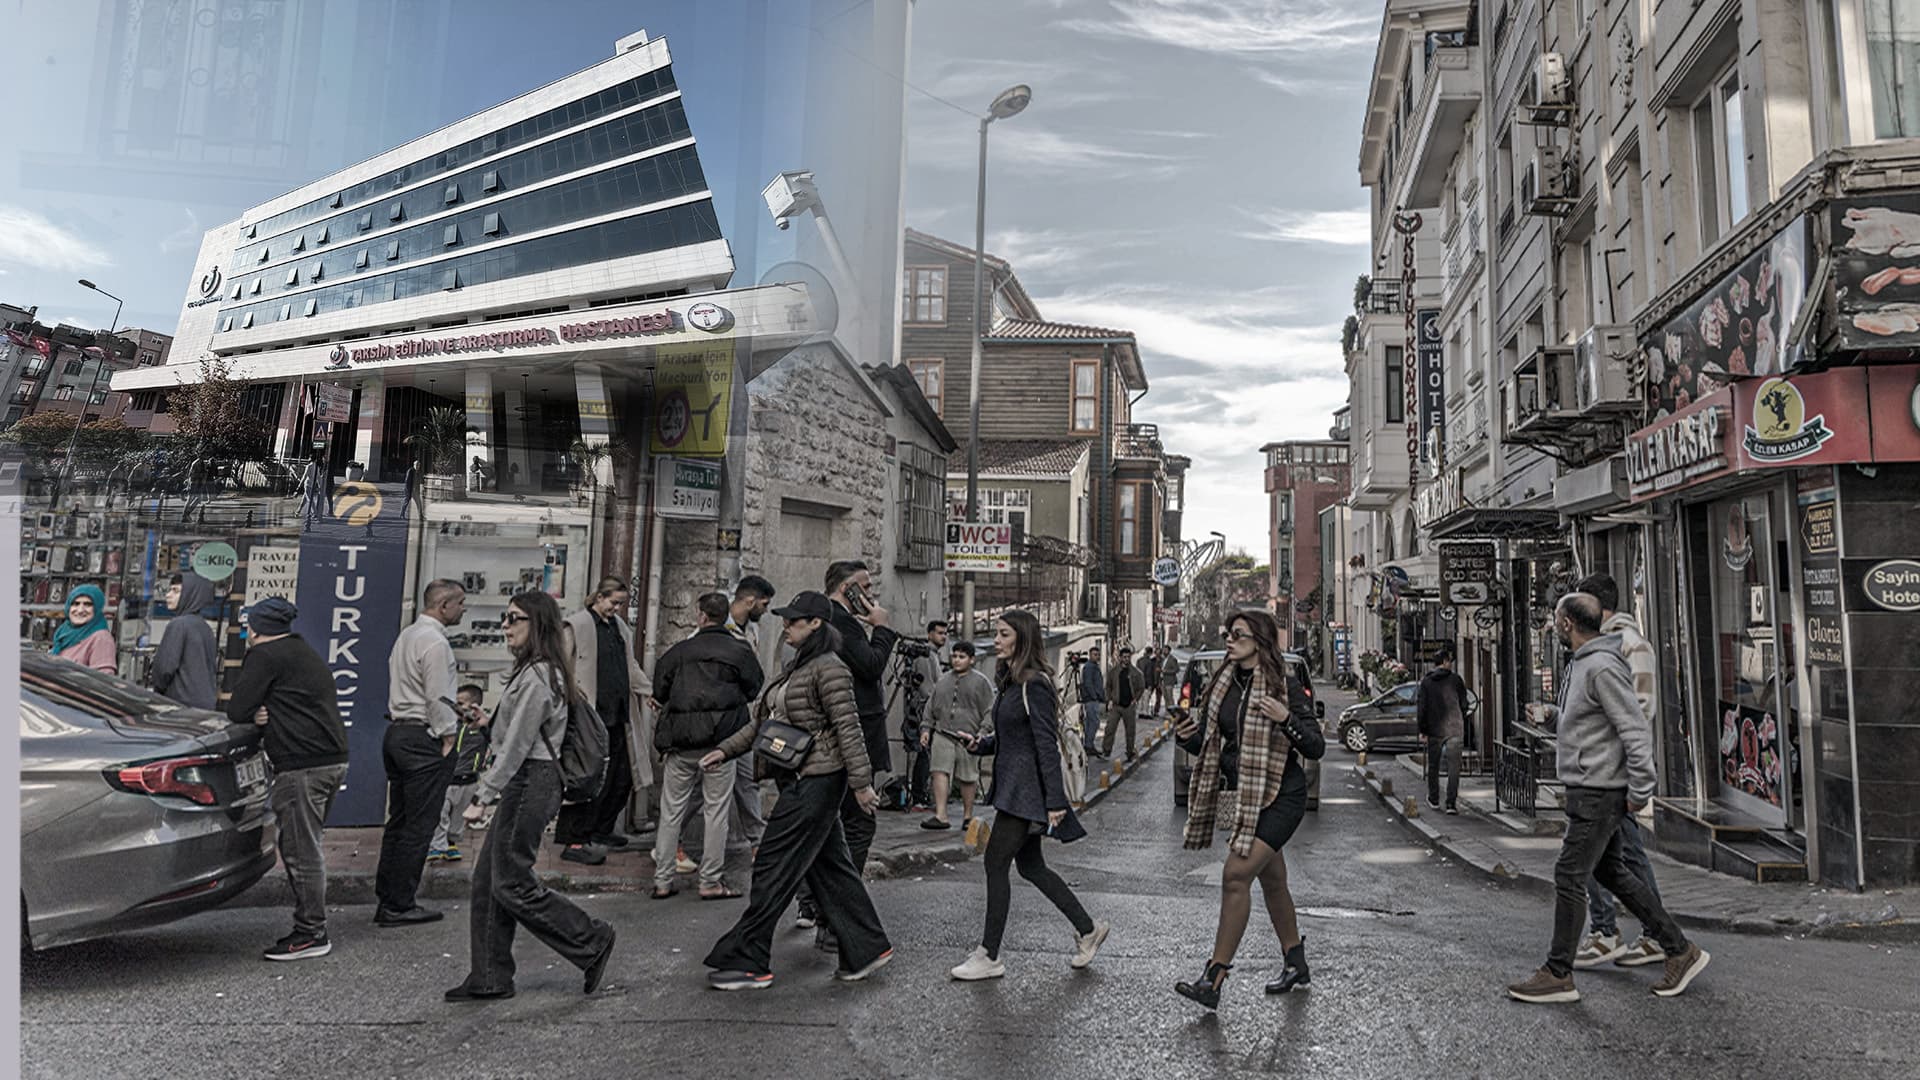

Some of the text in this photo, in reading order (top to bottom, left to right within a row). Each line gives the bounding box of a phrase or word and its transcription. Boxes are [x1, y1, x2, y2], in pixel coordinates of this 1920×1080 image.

[351, 344, 389, 361] TAKSİM
[394, 338, 434, 357] EĞİTİM
[438, 338, 453, 351] VE
[460, 327, 550, 351] ARAŞTIRMA
[560, 308, 673, 340] HASTANESİ
[705, 369, 727, 383] Yön
[1404, 336, 1416, 415] KONAK
[1428, 354, 1441, 426] HOTE
[1667, 406, 1719, 469] KASAP
[1778, 438, 1810, 454] KASAP
[1406, 421, 1418, 500] HOTEL
[961, 526, 995, 545] WC
[952, 546, 1000, 554] TOILET
[1441, 545, 1494, 556] HARBOUR
[207, 554, 234, 567] Kliq
[1448, 558, 1487, 569] SUITES
[262, 564, 285, 574] SIM
[1442, 570, 1492, 581] OLD CITY
[1881, 589, 1920, 604] Hote
[1808, 617, 1842, 645] Gloria
